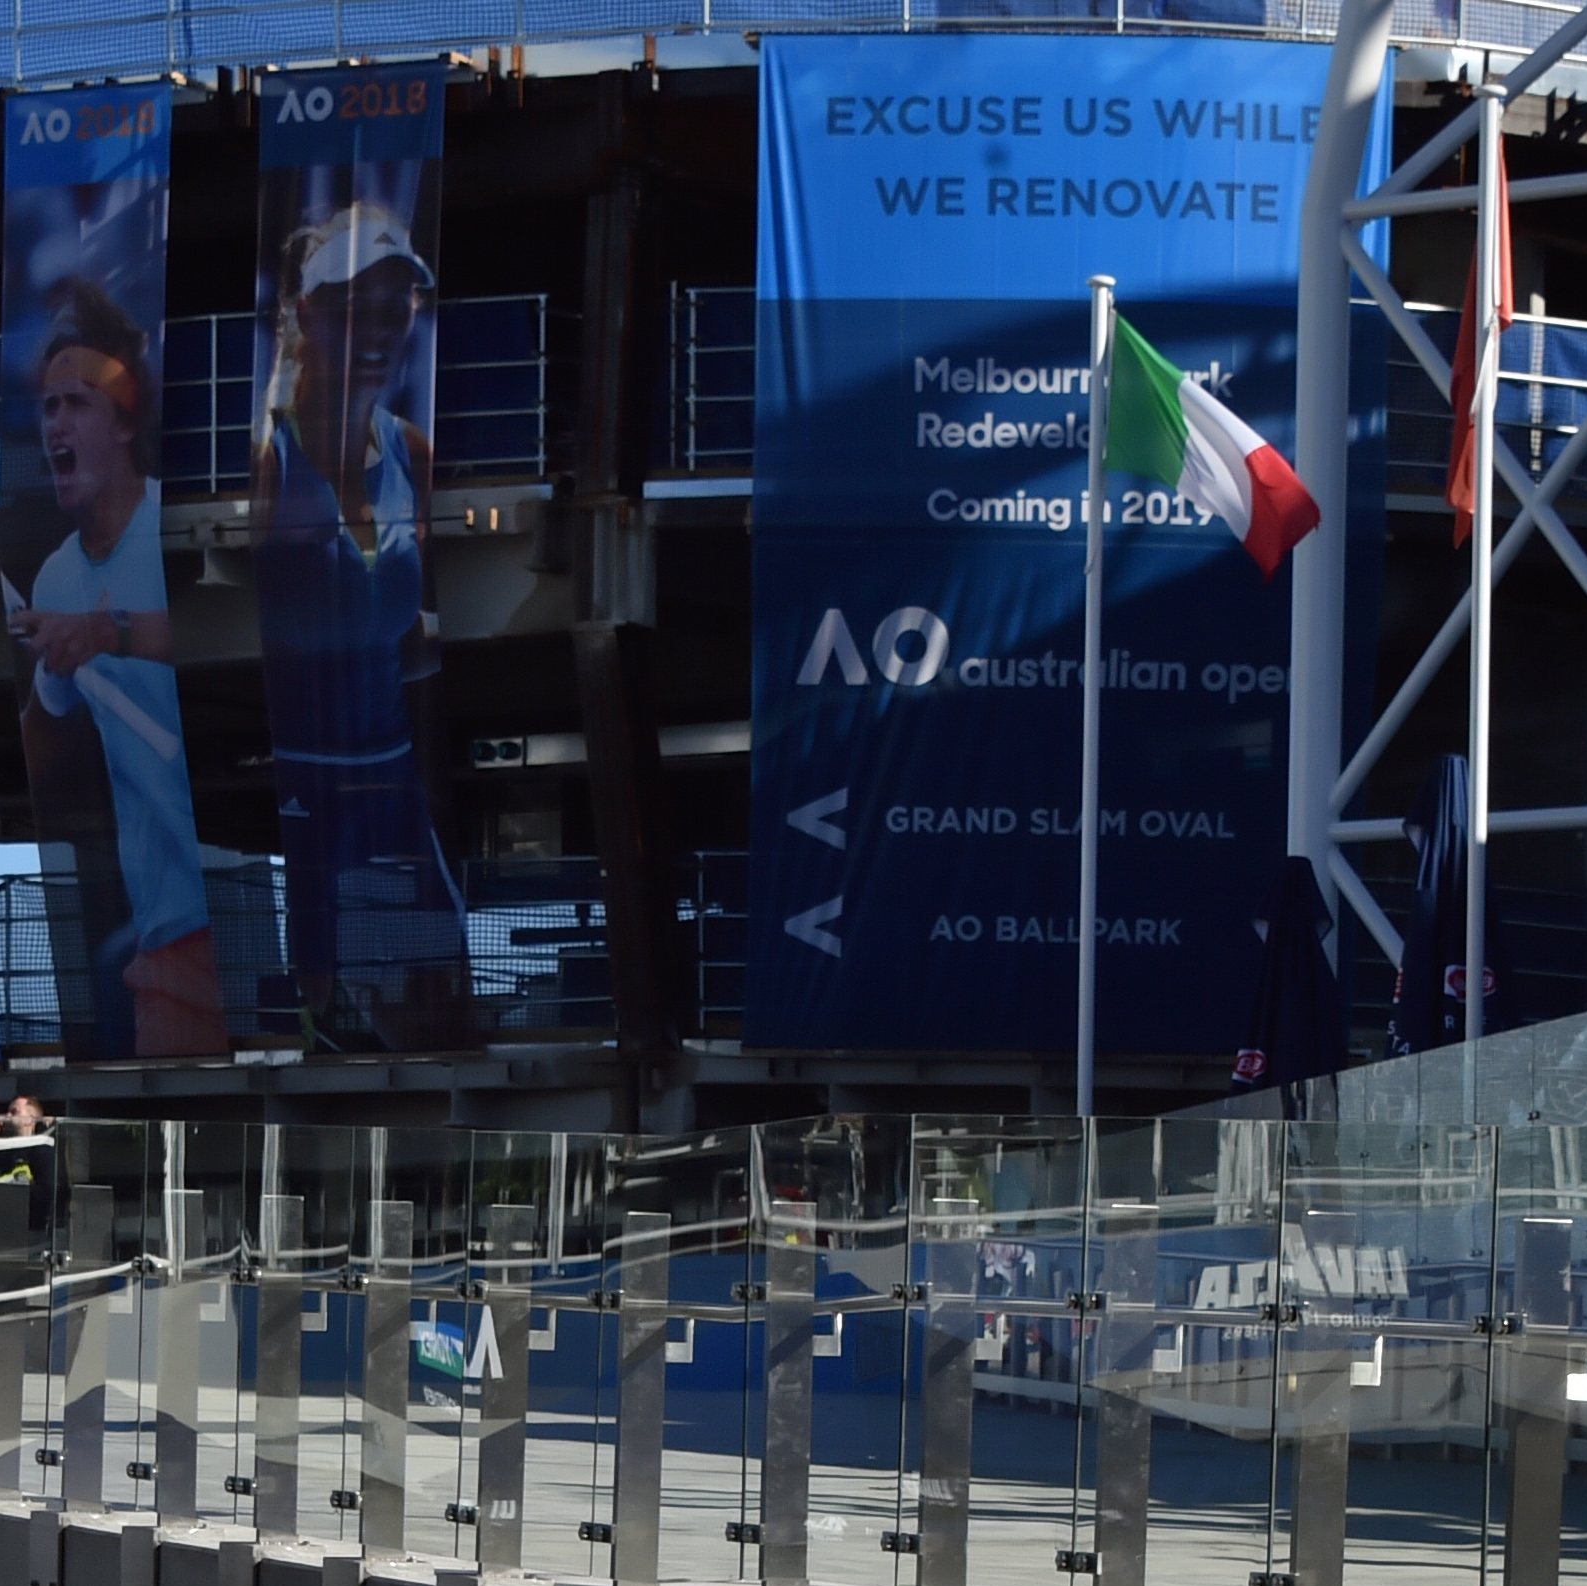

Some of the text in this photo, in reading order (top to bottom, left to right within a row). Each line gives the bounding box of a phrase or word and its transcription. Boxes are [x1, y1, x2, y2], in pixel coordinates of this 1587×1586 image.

[20, 100, 154, 145] AO 2018
[277, 80, 426, 123] AO 2018
[827, 96, 1321, 145] EXCUSE US WHILE
[875, 176, 1280, 223] WE RENOVATE
[914, 357, 1109, 395] Melbourn
[916, 412, 1090, 449] Redevelo
[927, 489, 1071, 531] Coming
[796, 606, 950, 687] AO
[1201, 660, 1290, 703] ope
[886, 806, 1017, 834] GRAND
[1139, 810, 1235, 839] OVAL
[929, 914, 1182, 945] AO BALLPARK
